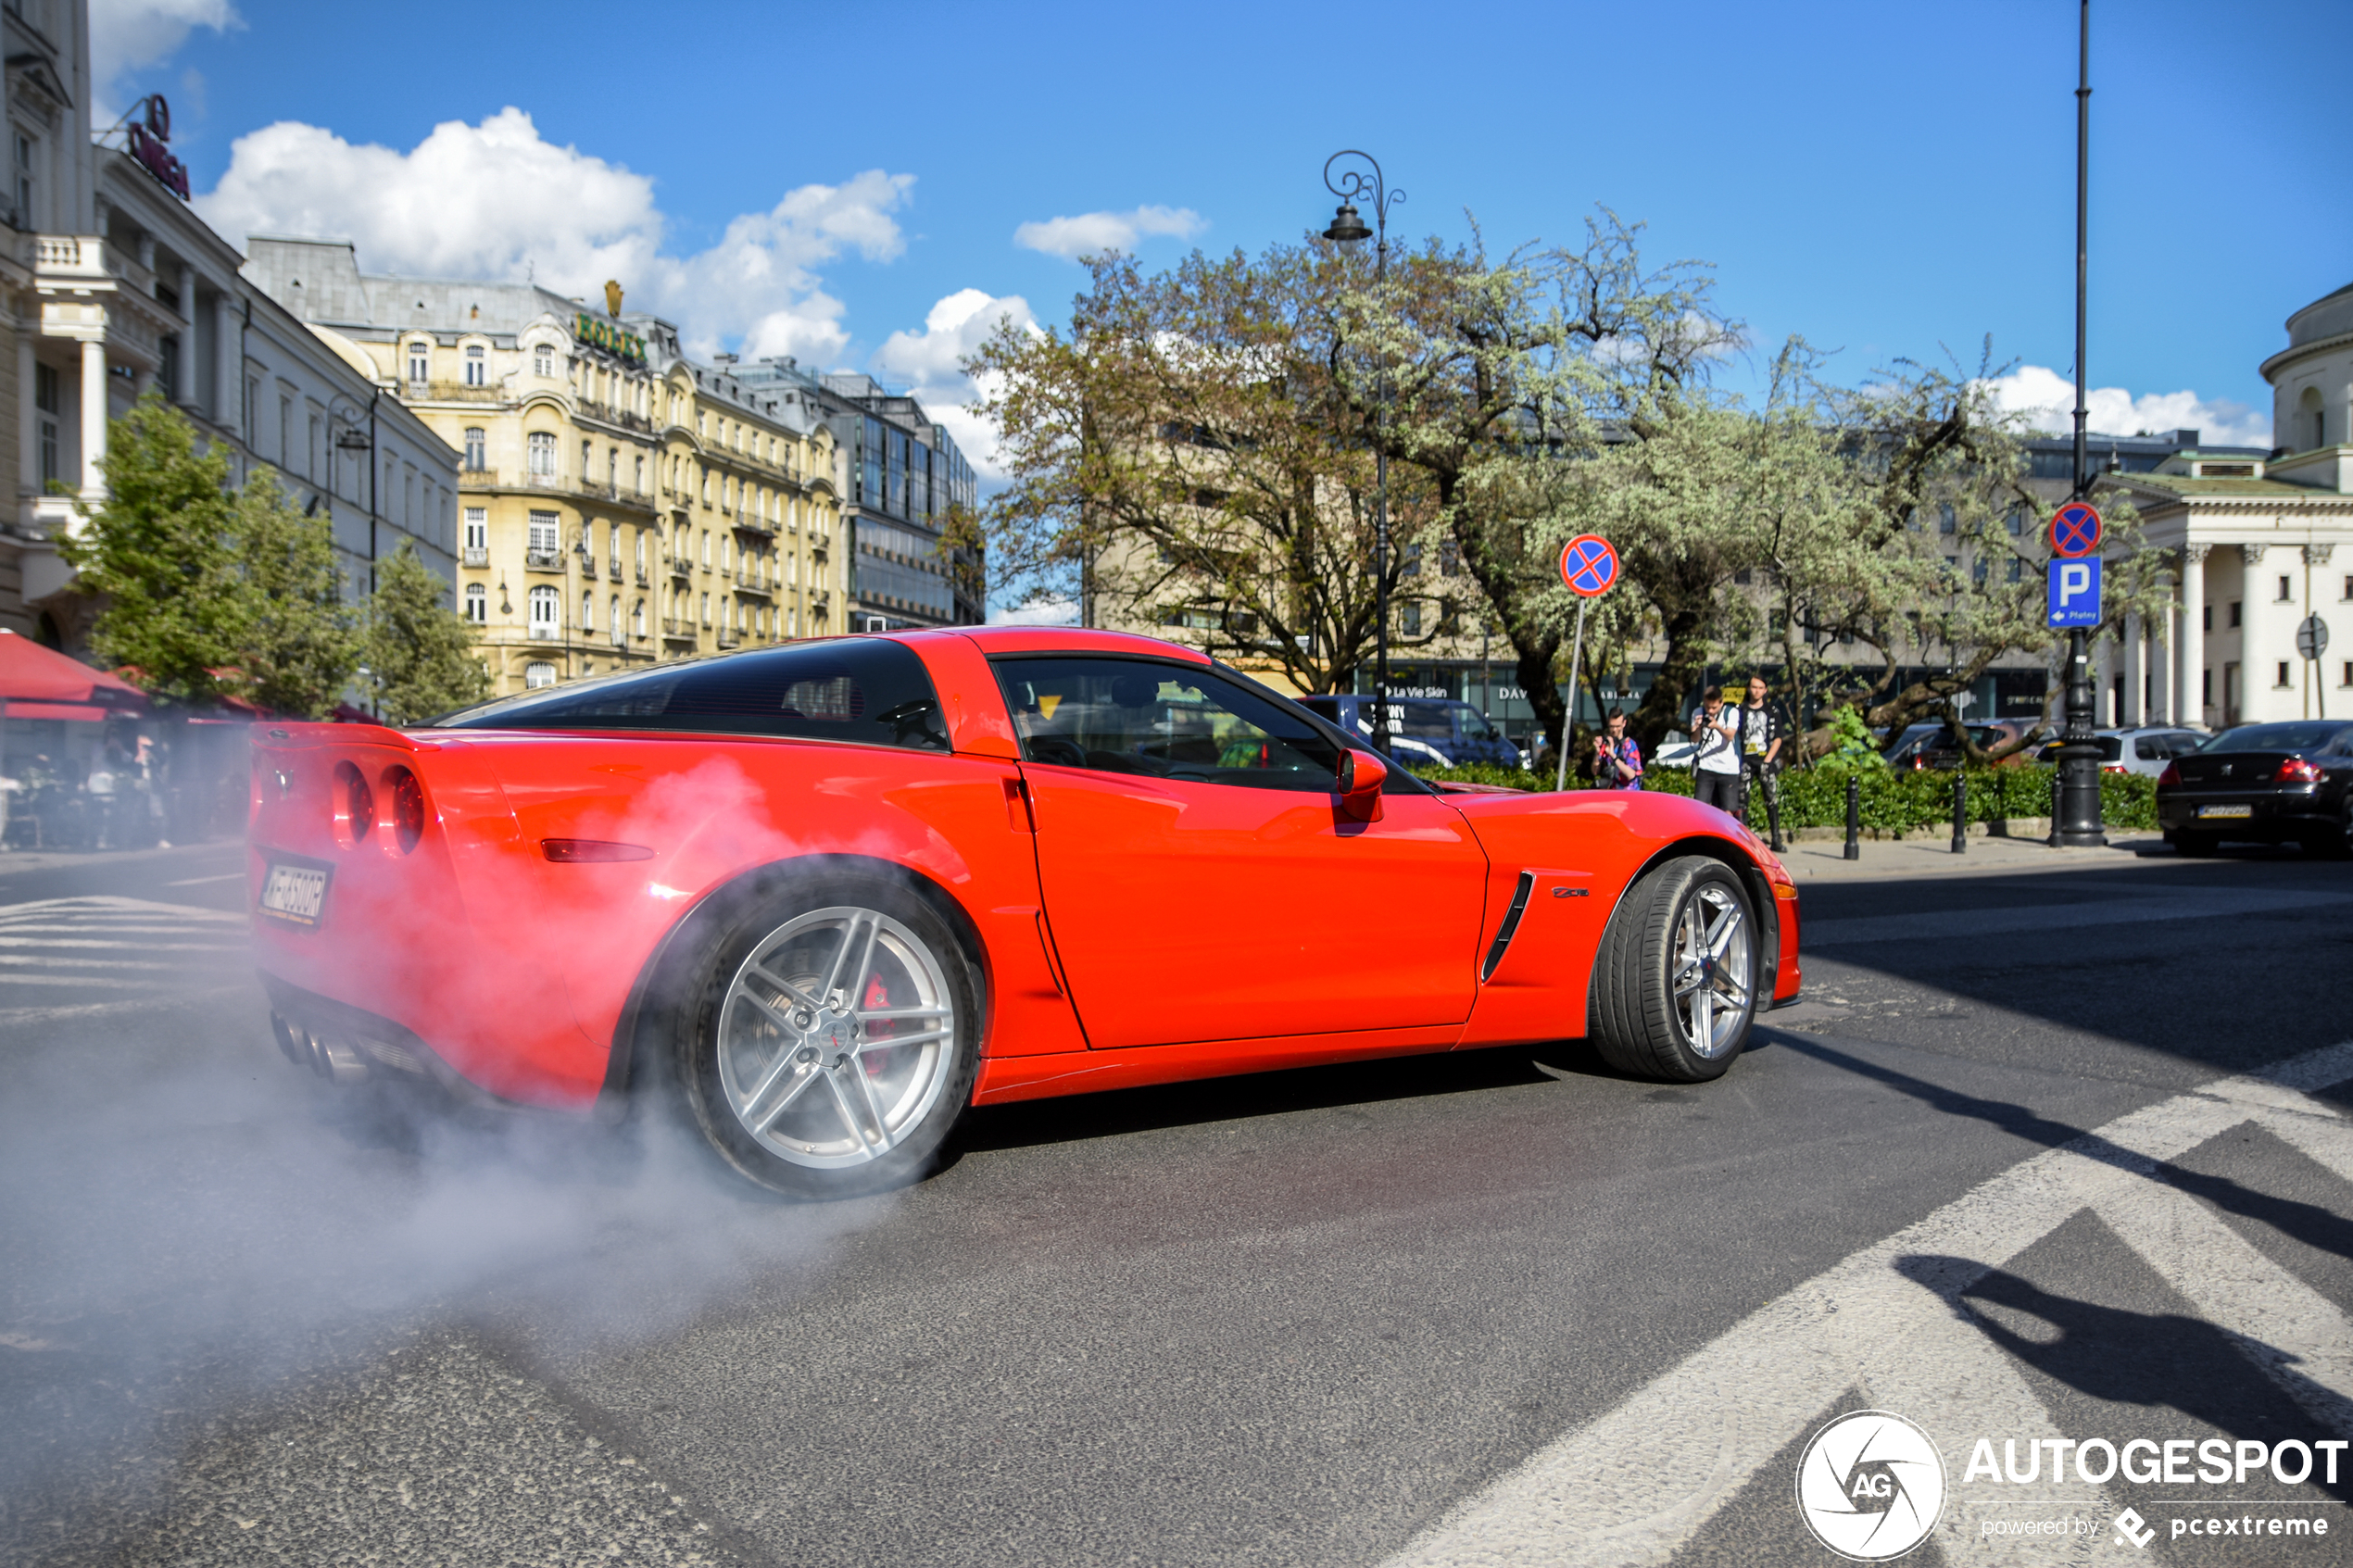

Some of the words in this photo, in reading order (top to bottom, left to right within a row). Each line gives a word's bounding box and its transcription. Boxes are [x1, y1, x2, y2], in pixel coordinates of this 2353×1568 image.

[575, 312, 648, 362] ROLEX
[2059, 563, 2090, 607] P
[1393, 686, 1406, 698] La
[1406, 686, 1425, 698] Vie
[1425, 686, 1447, 698] Skin
